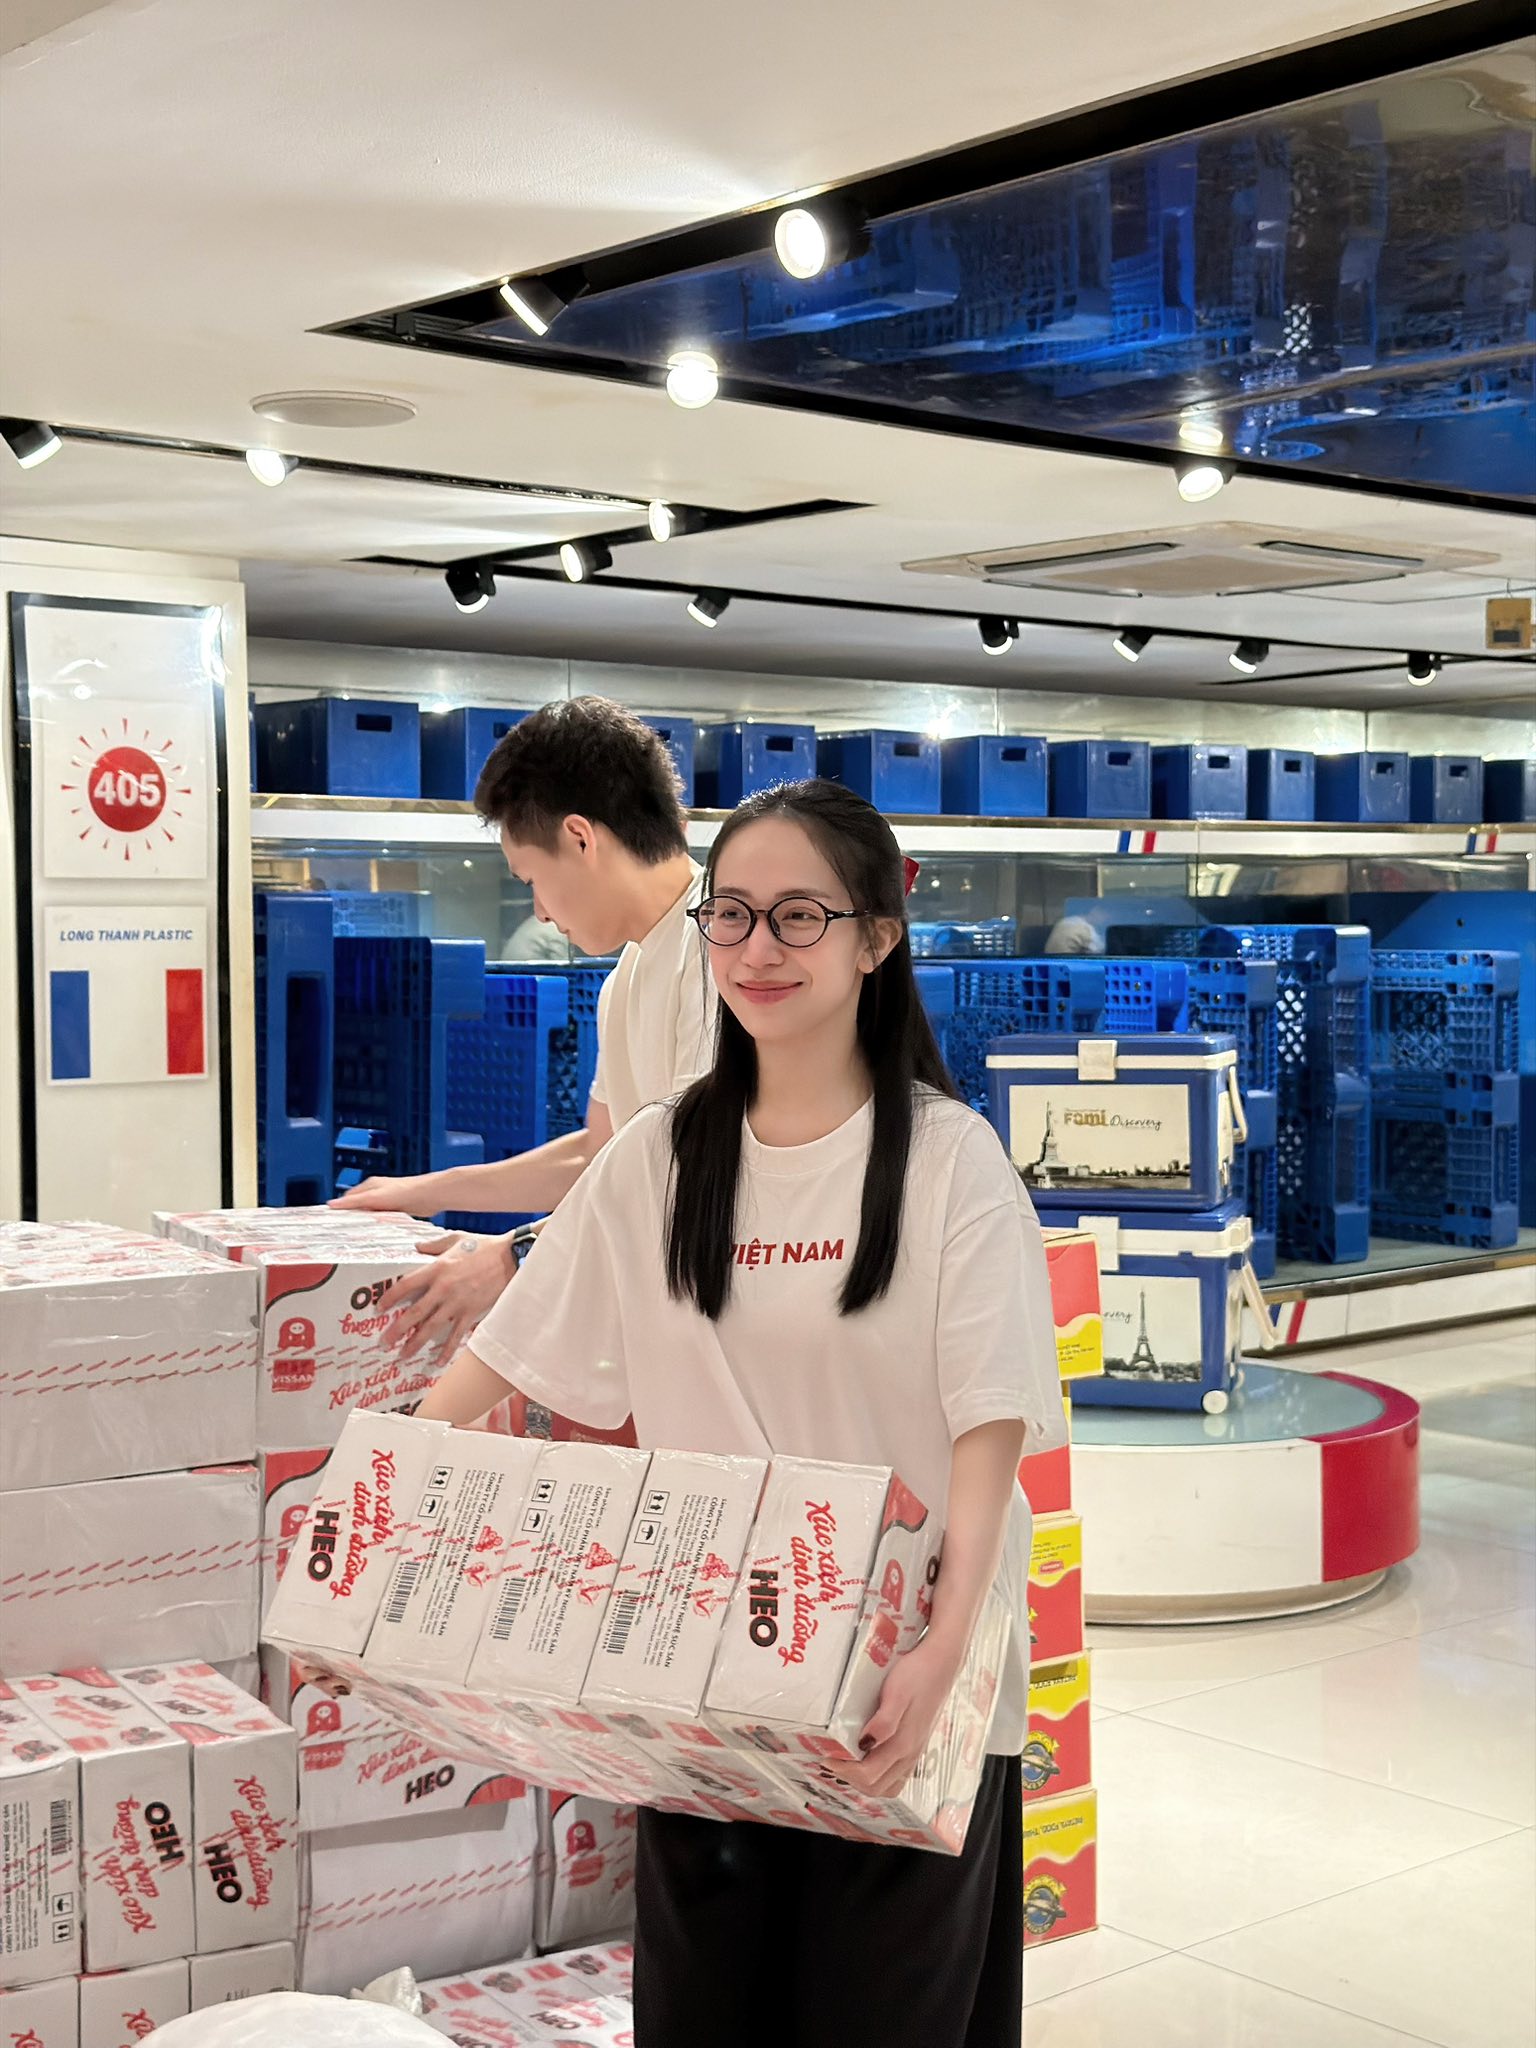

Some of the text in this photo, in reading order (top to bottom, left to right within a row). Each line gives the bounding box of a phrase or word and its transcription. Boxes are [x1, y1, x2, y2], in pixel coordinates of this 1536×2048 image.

[93, 771, 161, 807] 405
[60, 929, 193, 942] LONG THANH PLASTIC
[1064, 1110, 1162, 1131] Fami Discovery
[781, 1239, 844, 1264] NAM
[272, 1374, 315, 1384] VISSAN
[371, 1449, 396, 1493] Xúc
[371, 1495, 395, 1544] xích
[588, 1508, 596, 1516] TY
[703, 1519, 712, 1528] TY
[706, 1496, 720, 1518] CÔNG
[308, 1510, 340, 1582] HEO
[329, 1481, 372, 1600] dinh dưỡng
[805, 1501, 844, 1602] Xúc xích
[750, 1569, 778, 1647] HEO
[778, 1536, 819, 1667] dinh dưỡng
[404, 1764, 456, 1805] HEO
[144, 1801, 185, 1864] HEO
[203, 1842, 243, 1903] HEO
